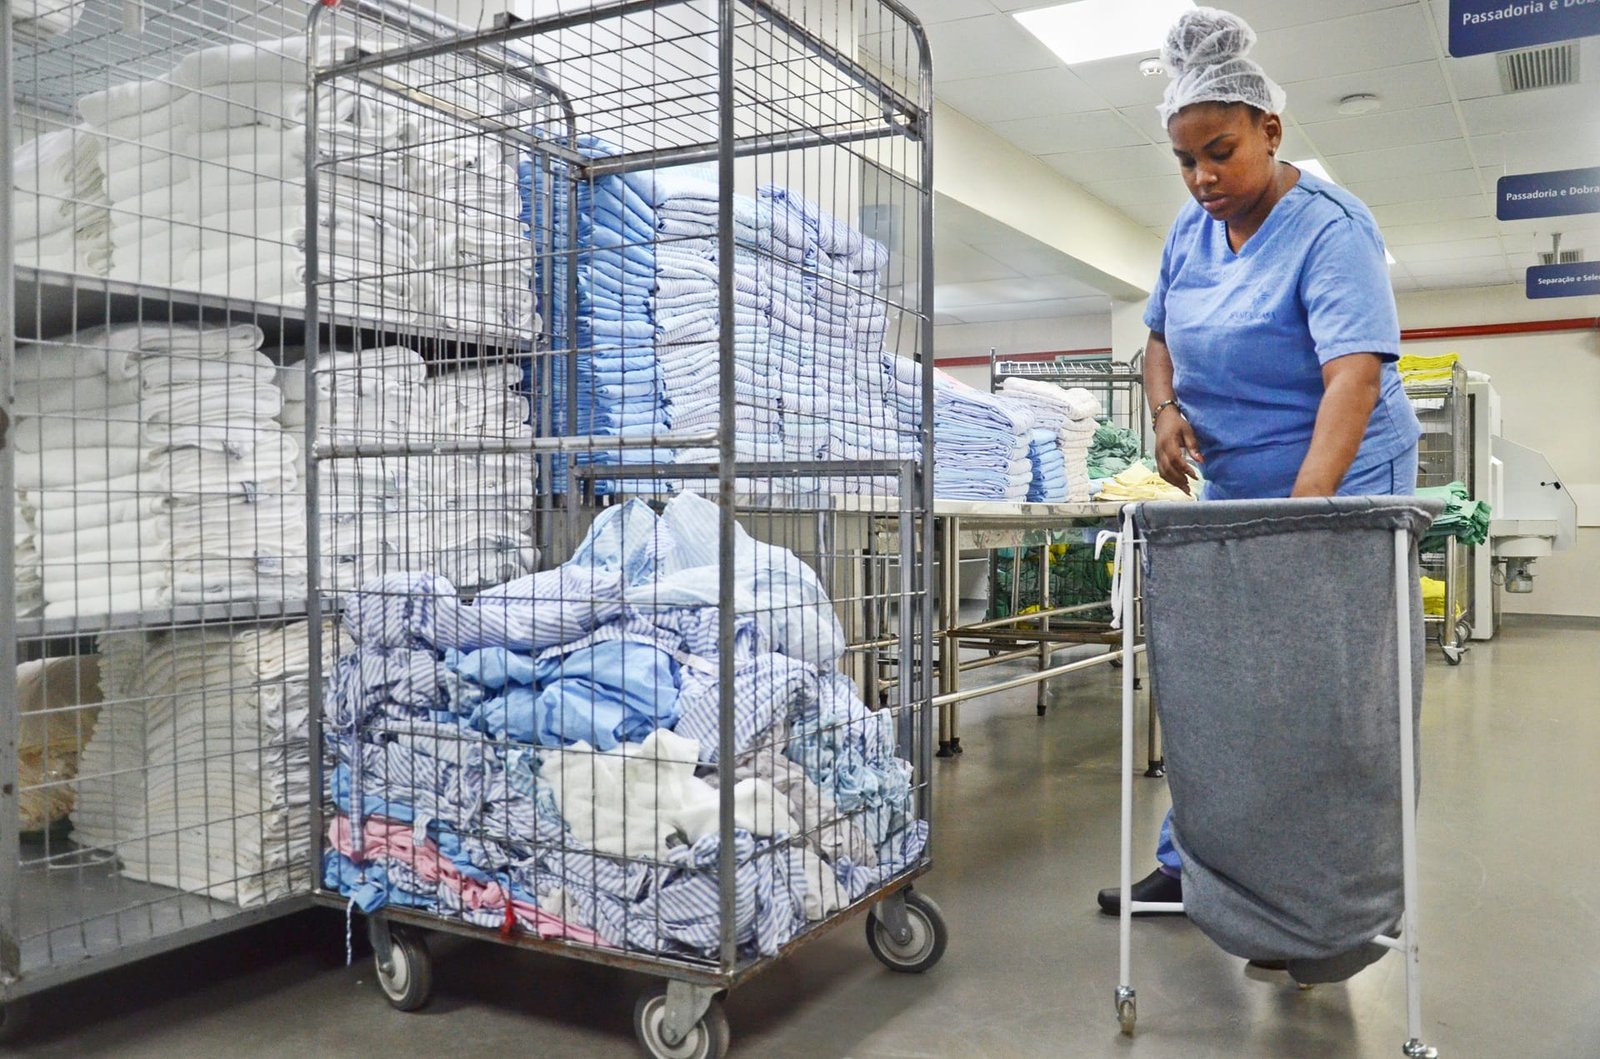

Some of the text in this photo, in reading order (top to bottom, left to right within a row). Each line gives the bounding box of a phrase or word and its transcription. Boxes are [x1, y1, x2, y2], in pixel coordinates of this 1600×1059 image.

[1462, 1, 1543, 25] Passadoria
[1549, 0, 1559, 10] e
[1506, 188, 1557, 201] Passadoria
[1537, 276, 1575, 286] Separação
